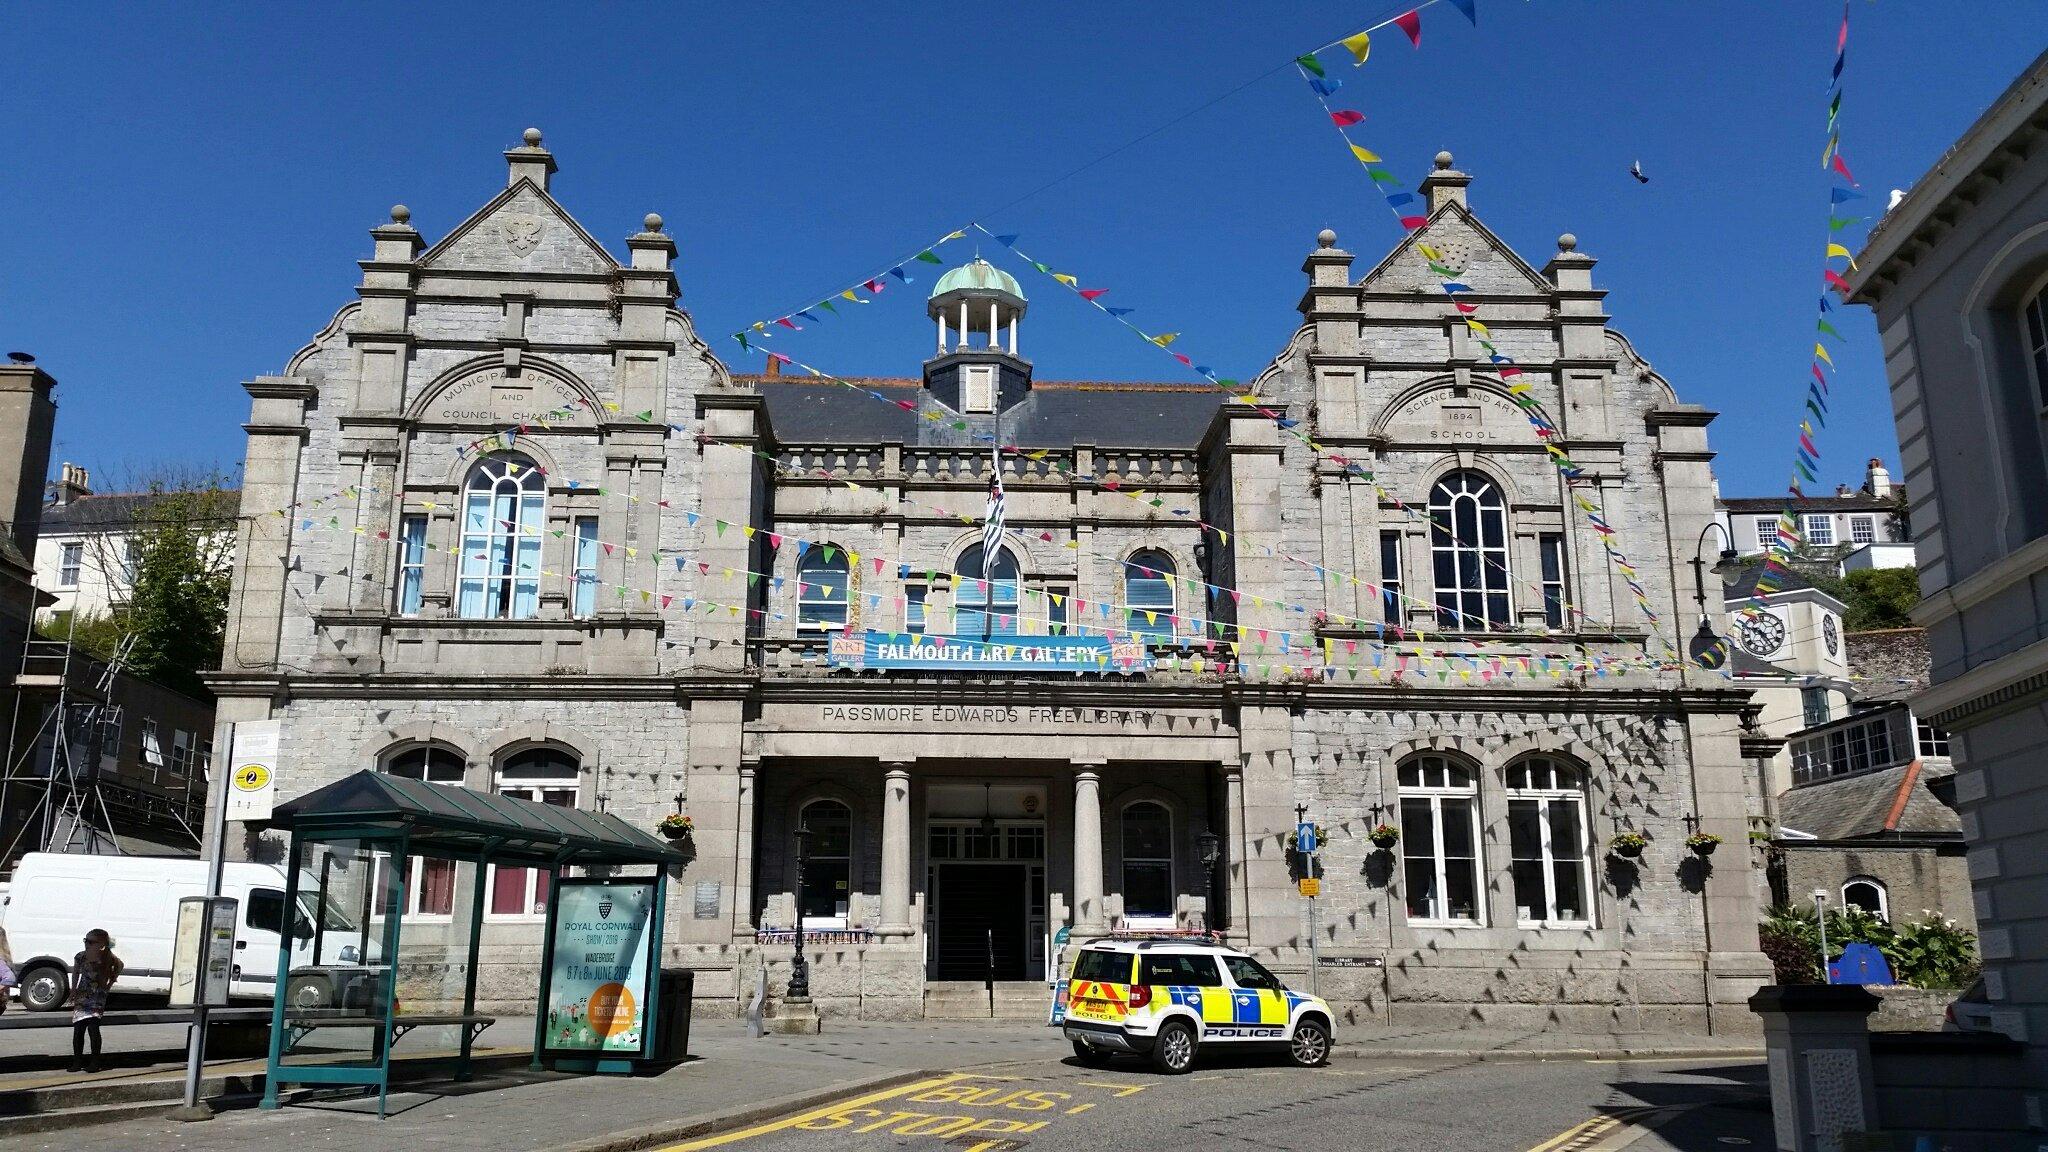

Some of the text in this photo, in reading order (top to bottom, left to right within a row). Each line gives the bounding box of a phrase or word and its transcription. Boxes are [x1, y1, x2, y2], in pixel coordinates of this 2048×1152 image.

[444, 372, 579, 405] MUNICIPA OFFICES
[1406, 391, 1455, 415] SCIENCE
[1494, 400, 1518, 416] ART
[442, 410, 501, 420] COUNCIL
[1430, 430, 1496, 439] SCHOOL
[834, 641, 863, 651] ART
[1113, 646, 1143, 656] ART
[832, 654, 865, 662] GALLERY
[878, 643, 973, 661] FALMOUTH
[1021, 646, 1099, 663] GALLERY
[822, 707, 924, 721] PASSMORE
[932, 708, 1018, 723] EDWARDS
[1029, 709, 1075, 723] FREE
[247, 771, 256, 784] 2
[564, 922, 642, 931] ROYAL CORNWALL
[585, 952, 615, 963] WADEBRIDGE
[594, 965, 612, 981] JUNE
[1075, 1011, 1117, 1020] POLICE
[1203, 1028, 1284, 1038] POLICE
[906, 1085, 1073, 1111] BUS
[794, 1109, 1029, 1139] STOP
